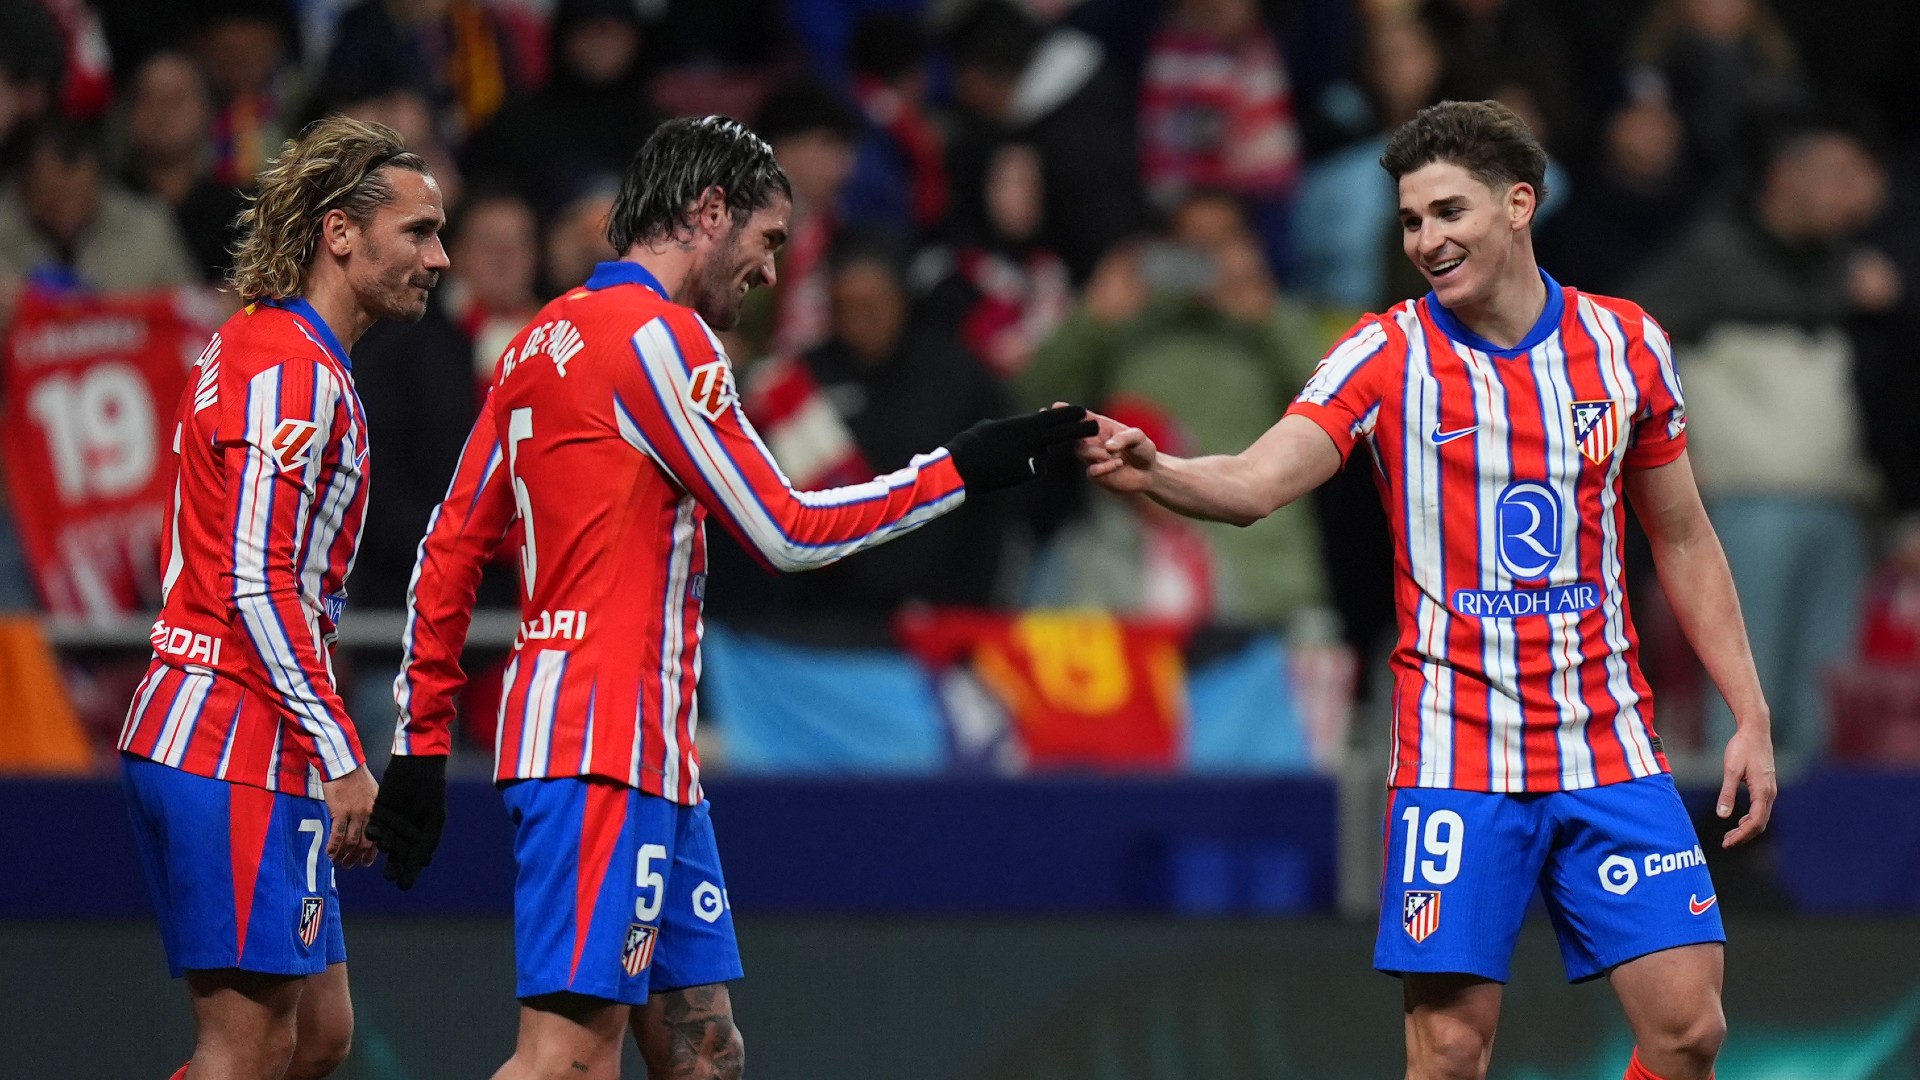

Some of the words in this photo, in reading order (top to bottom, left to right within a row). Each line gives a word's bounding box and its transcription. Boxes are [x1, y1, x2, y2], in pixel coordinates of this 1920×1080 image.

[541, 320, 585, 378] PAUL
[1458, 591, 1550, 615] RIYADH
[1558, 586, 1596, 610] AIR
[299, 819, 324, 892] 7
[1402, 806, 1465, 885] 19
[1644, 845, 1707, 877] ComA
[636, 844, 667, 922] 5
